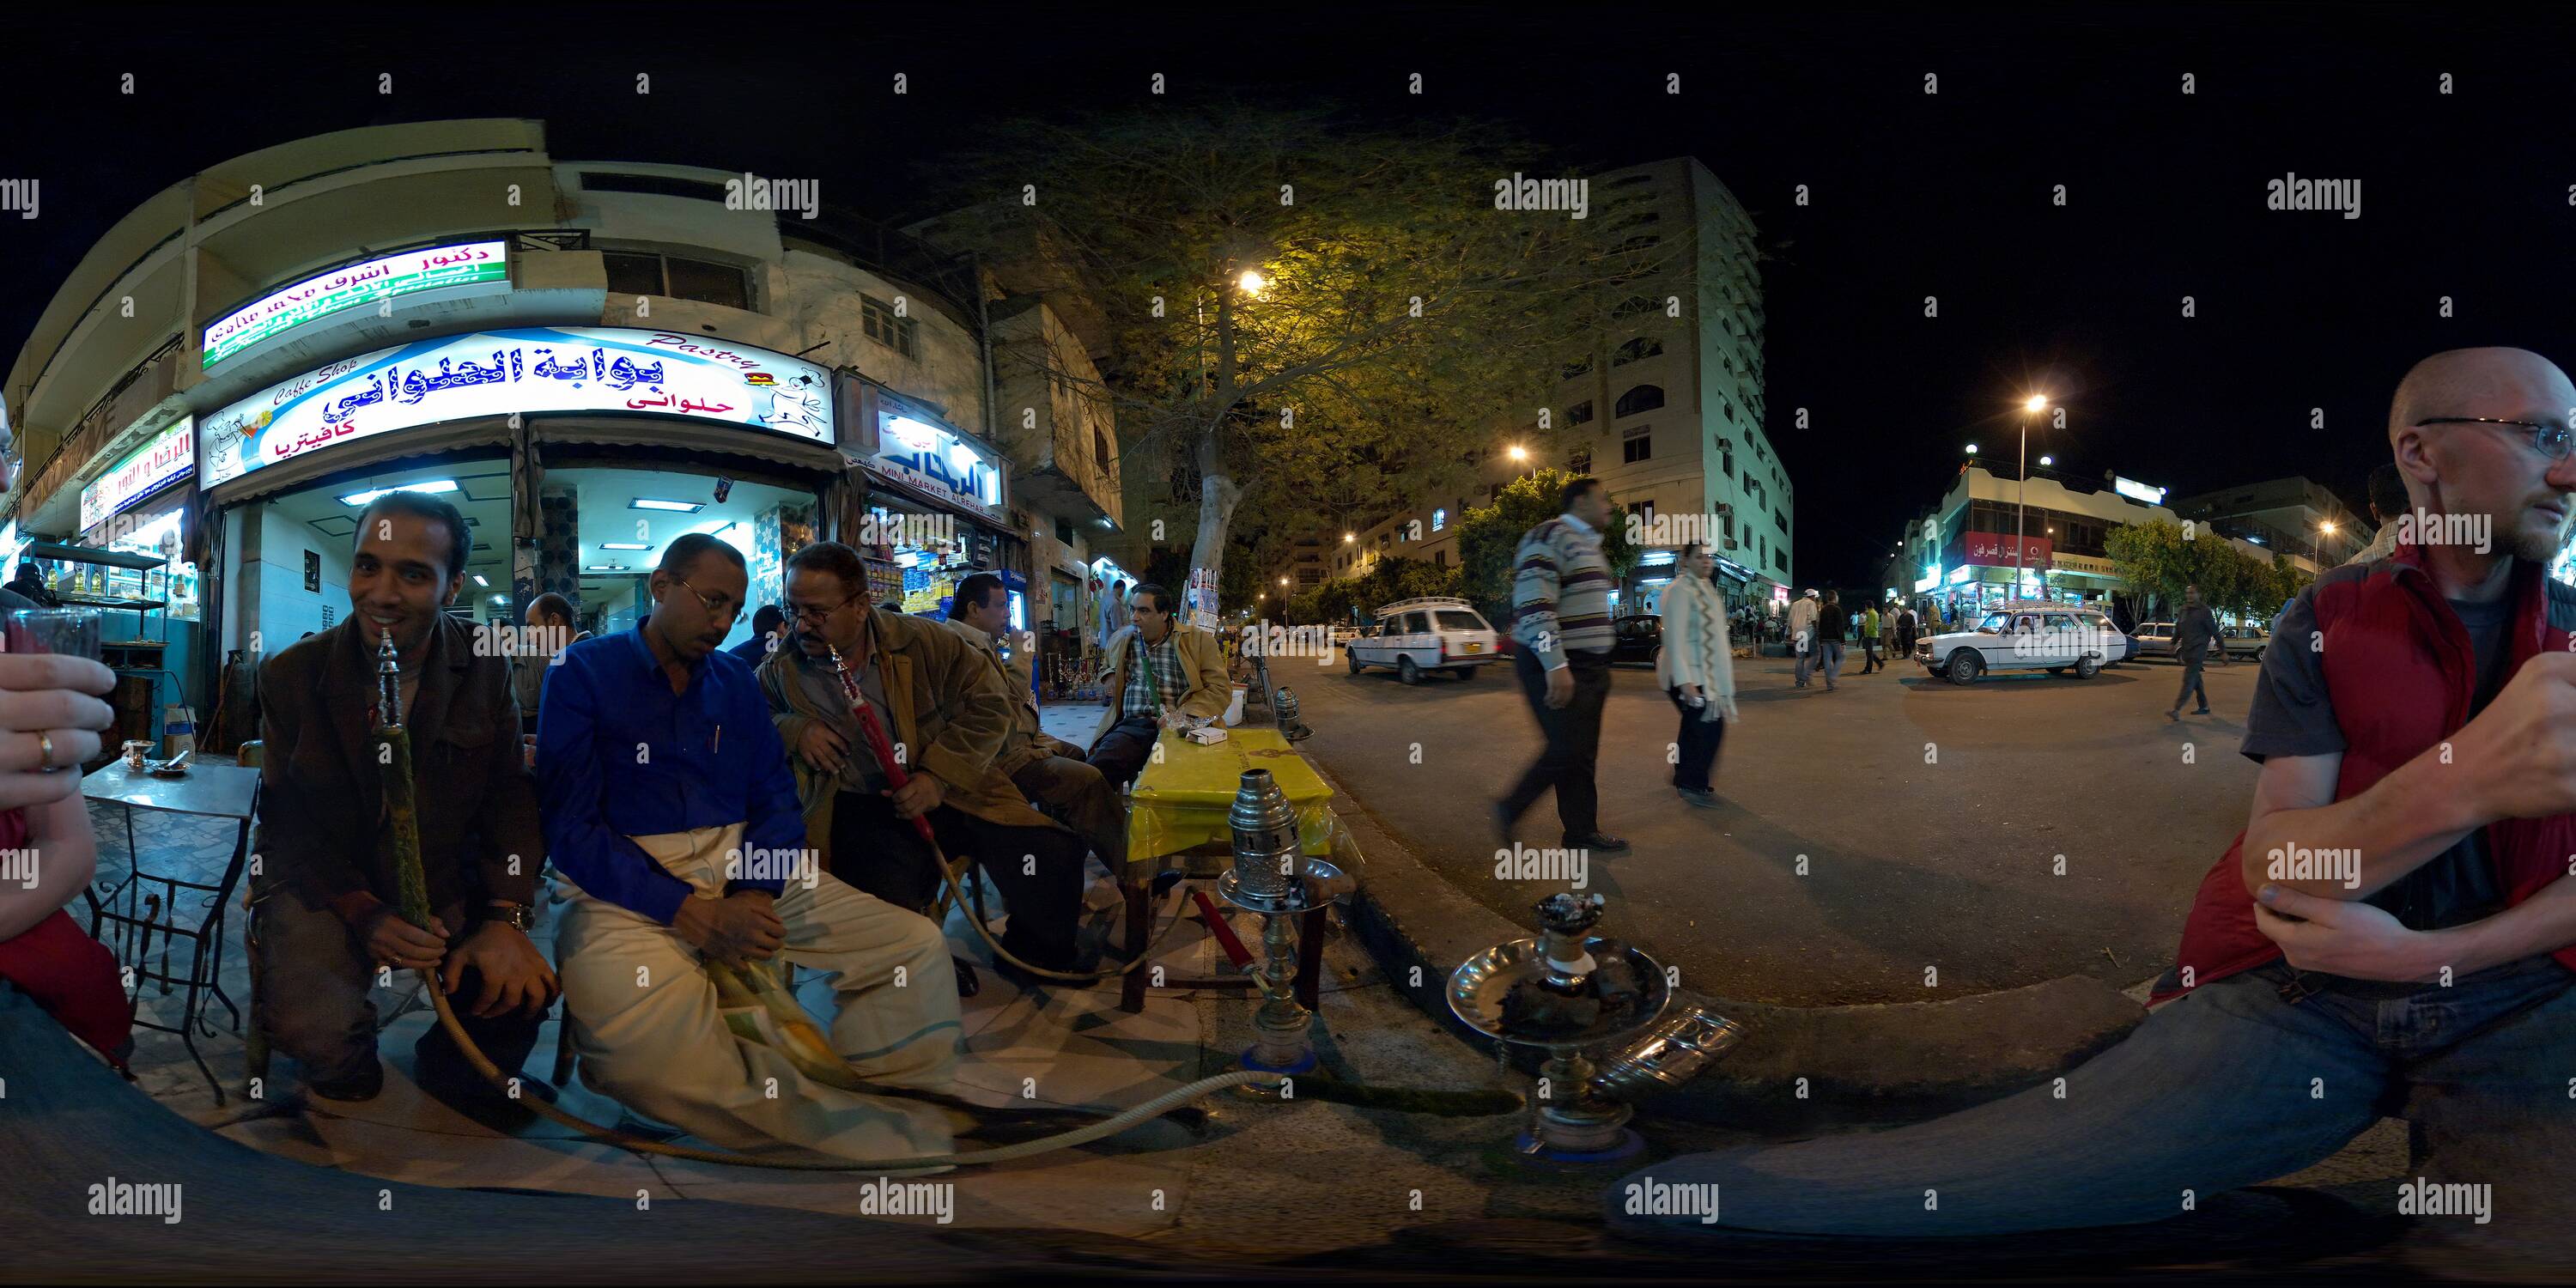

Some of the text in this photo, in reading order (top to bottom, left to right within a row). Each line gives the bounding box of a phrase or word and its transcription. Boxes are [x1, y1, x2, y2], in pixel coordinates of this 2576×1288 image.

[422, 247, 489, 270] دكتور
[534, 347, 665, 393] بوابة
[646, 333, 764, 370] Pastry
[273, 357, 359, 406] Caffe Shop
[275, 419, 355, 458] كافيتريا
[879, 452, 984, 500] الرحاب
[881, 465, 985, 514] MINI MARKET ALREHAB
